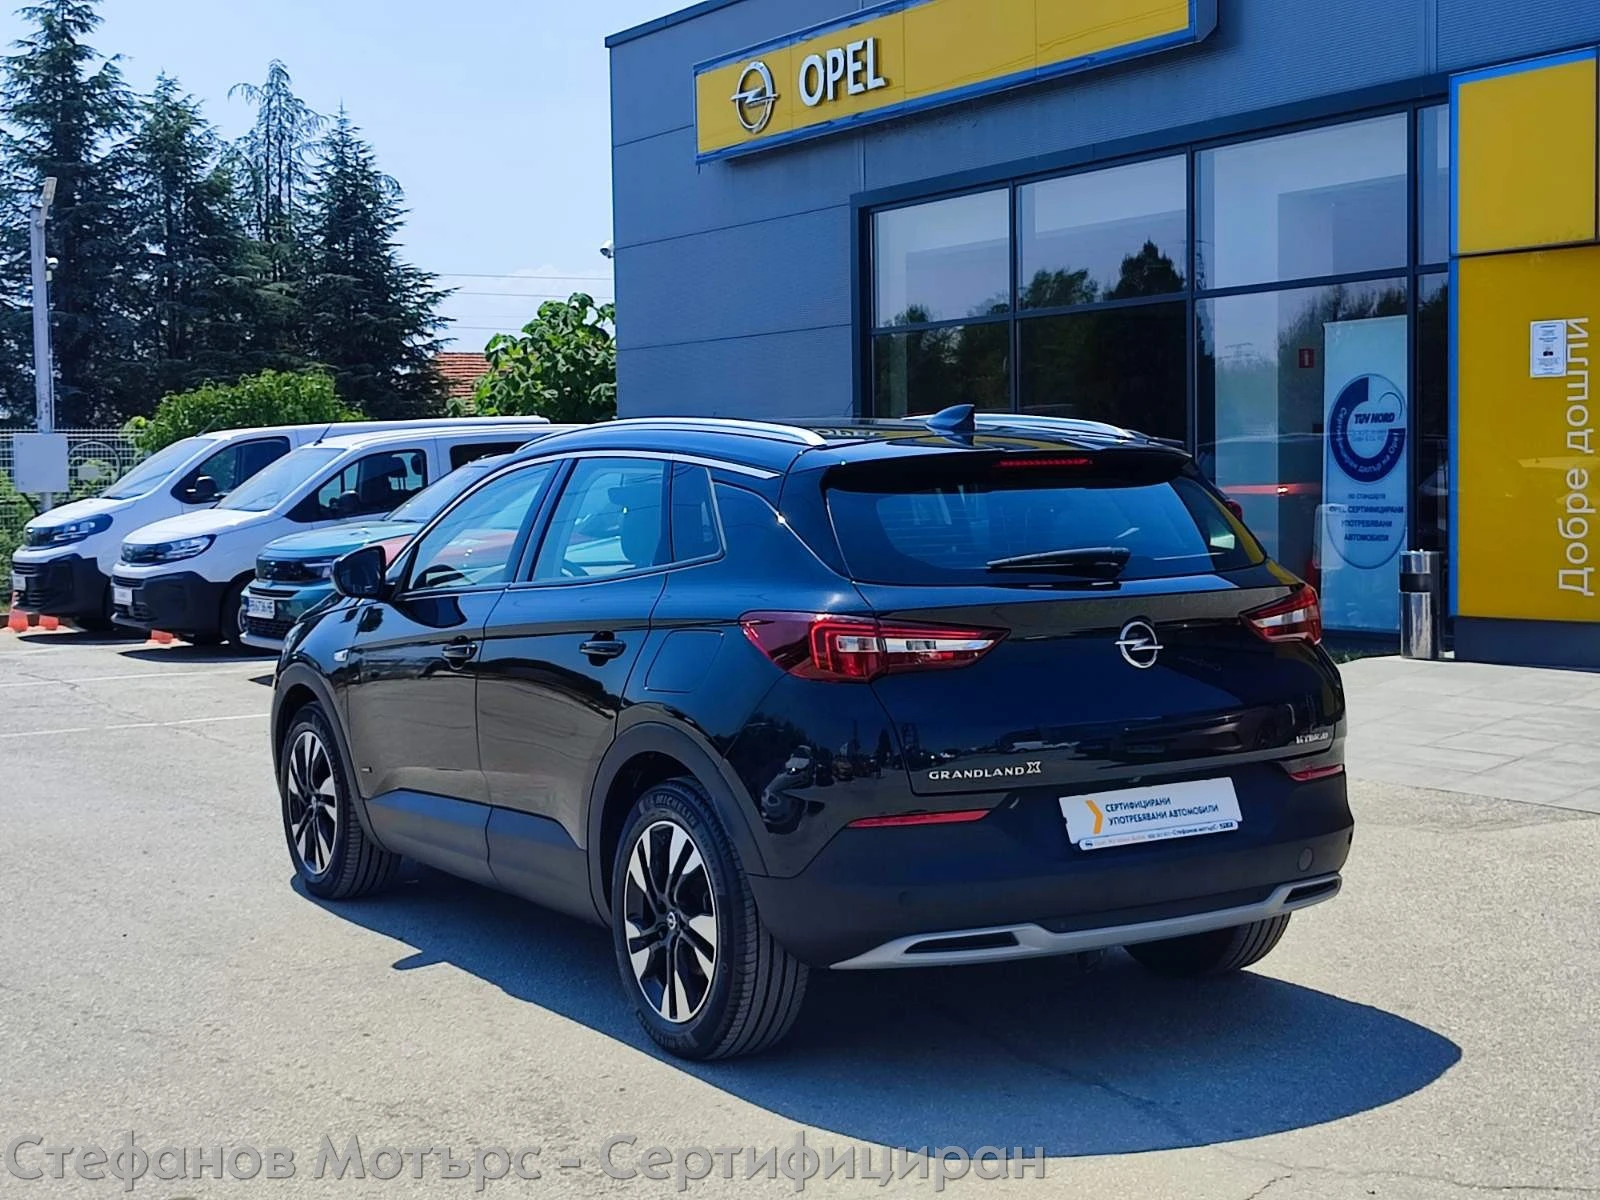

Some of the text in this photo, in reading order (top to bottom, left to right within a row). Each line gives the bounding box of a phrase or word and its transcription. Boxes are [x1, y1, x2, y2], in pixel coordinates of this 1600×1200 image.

[798, 36, 887, 107] OPEL
[1371, 412, 1396, 423] NORD
[1558, 317, 1596, 597] Добре дошли
[656, 795, 697, 827] MICHELIN
[1105, 797, 1172, 813] СЕРТИФИЦИРАНИ
[1108, 804, 1220, 826] УПОТРЕБЯВАНИ АВТОМОБИЛИ
